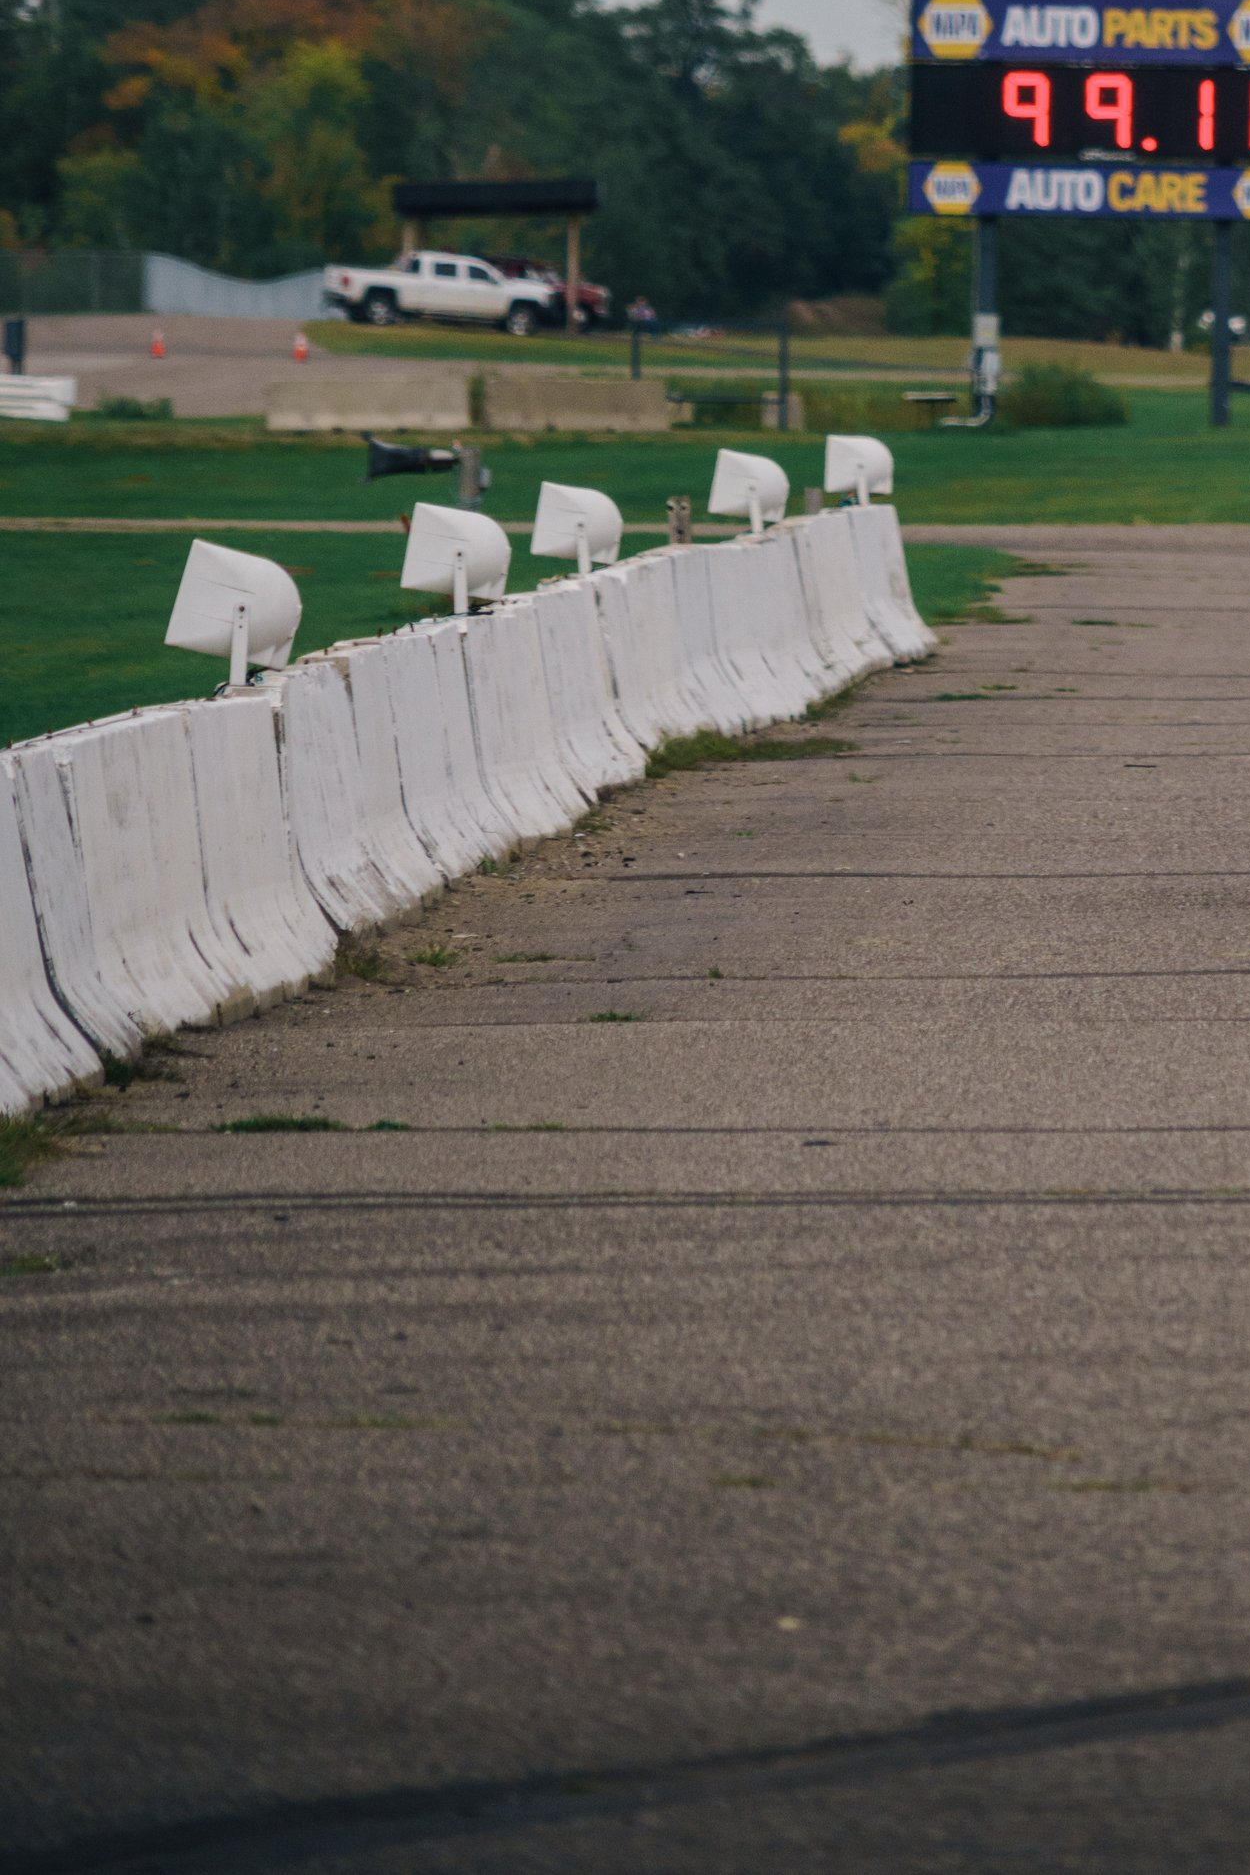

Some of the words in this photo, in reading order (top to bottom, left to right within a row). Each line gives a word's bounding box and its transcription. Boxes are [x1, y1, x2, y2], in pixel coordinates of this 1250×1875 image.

[1001, 6, 1099, 48] AUTO
[1102, 8, 1219, 50] PARTS
[1004, 168, 1103, 211] AUTO
[1107, 172, 1209, 213] CARE
